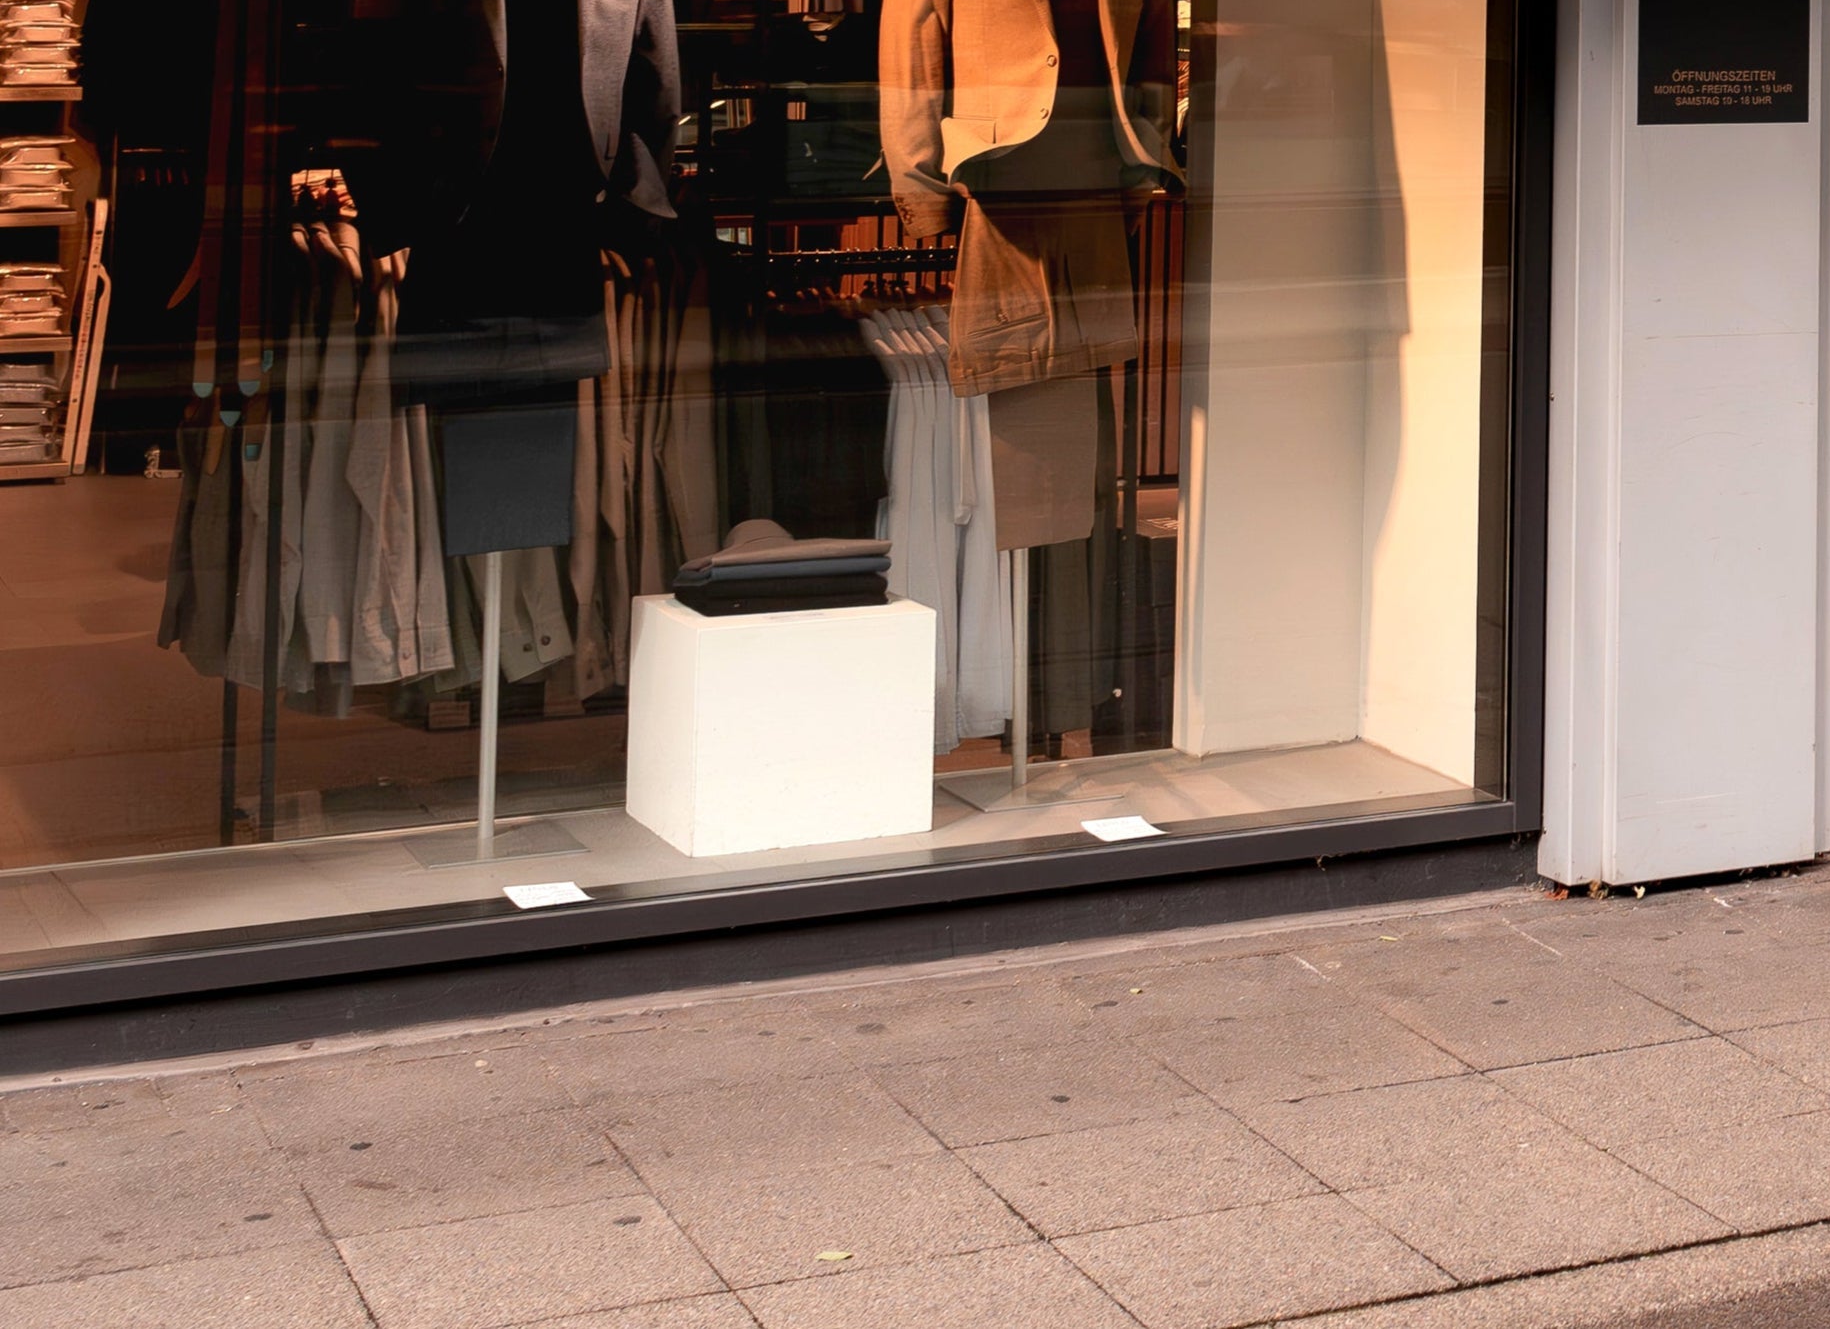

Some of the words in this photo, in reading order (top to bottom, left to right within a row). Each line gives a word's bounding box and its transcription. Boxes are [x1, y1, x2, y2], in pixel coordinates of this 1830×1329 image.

[1671, 69, 1776, 82] ÖFFNUNGSZEITEN
[1654, 85, 1694, 95] MONTAG
[1701, 84, 1741, 94] FREITAG
[1772, 83, 1793, 93] UHR
[1675, 96, 1720, 106] SAMSTAG
[1752, 96, 1772, 105] UHR
